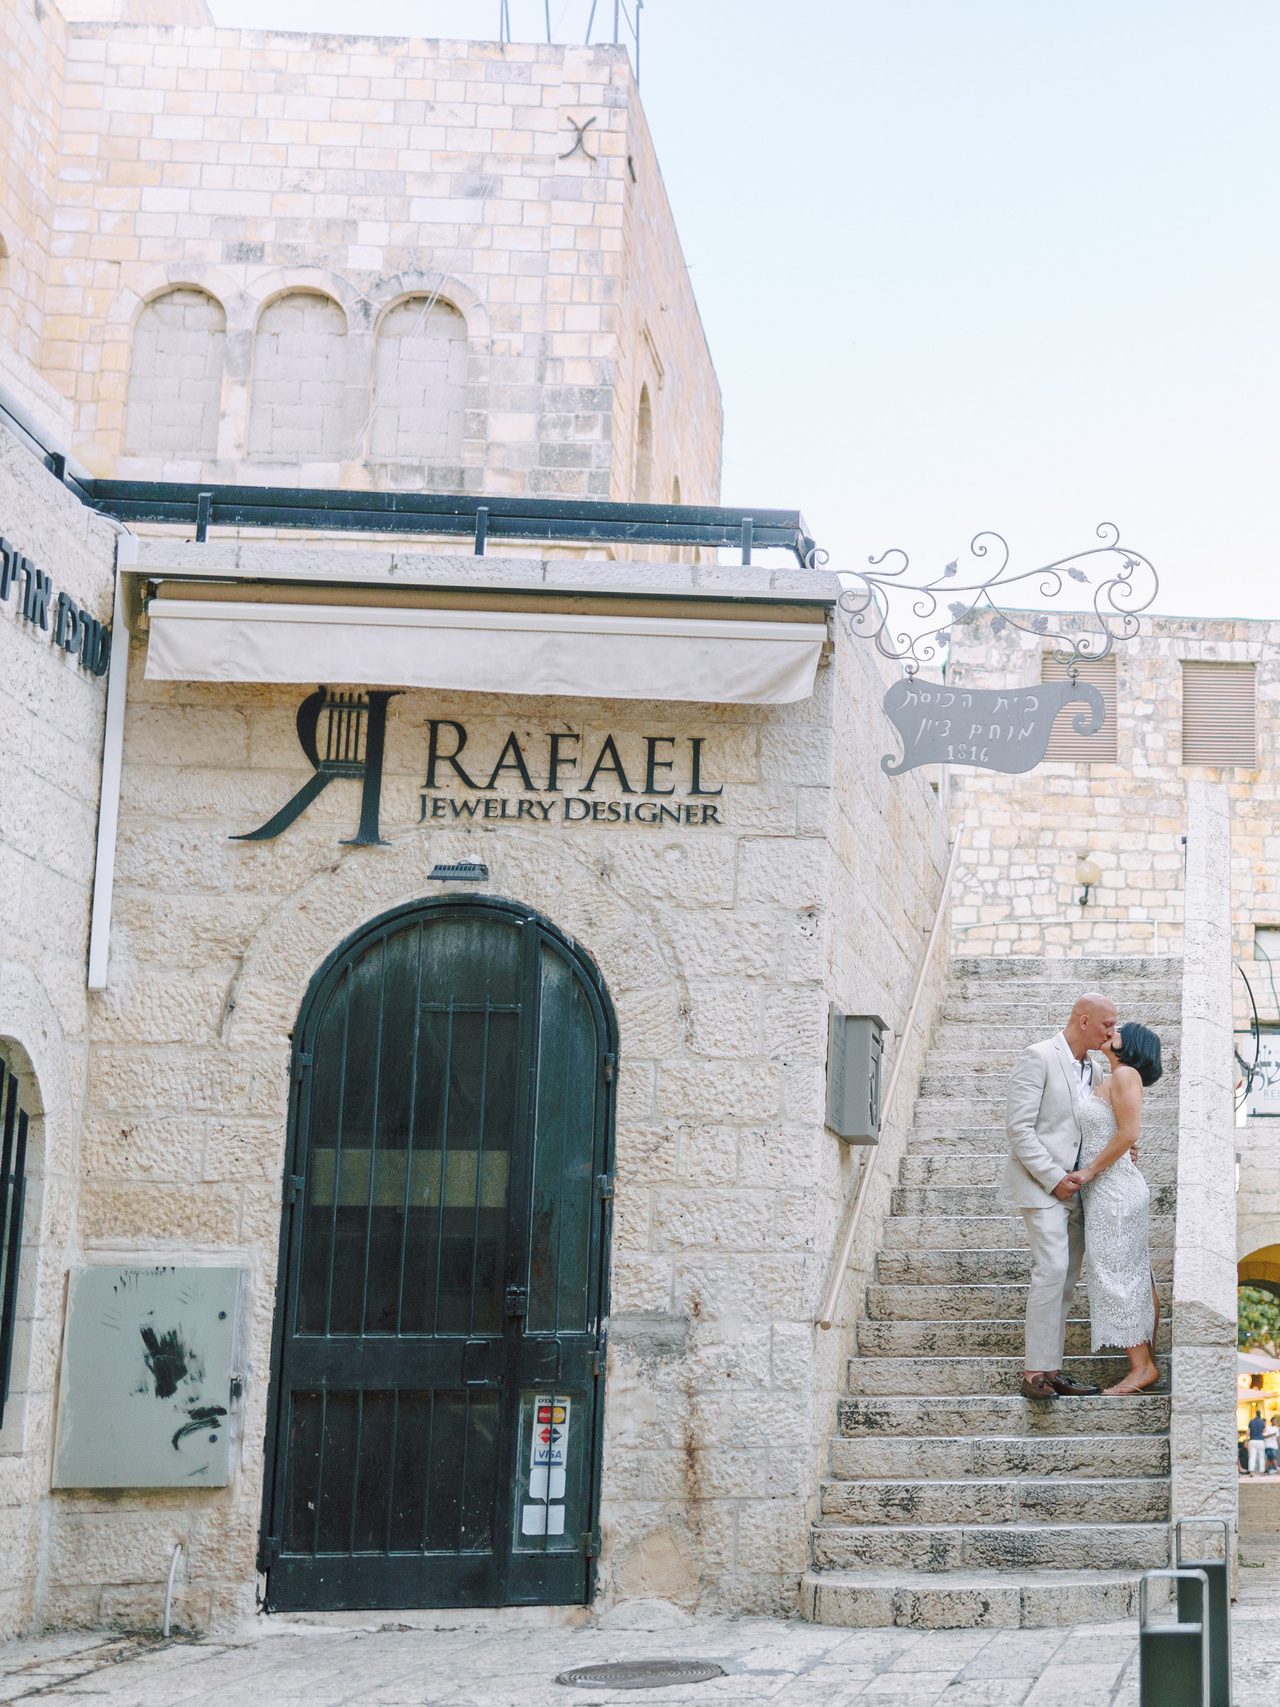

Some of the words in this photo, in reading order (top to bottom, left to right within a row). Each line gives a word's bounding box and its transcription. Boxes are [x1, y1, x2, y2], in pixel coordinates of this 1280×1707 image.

[896, 690, 972, 710] הכנסת
[992, 695, 1038, 714] בית
[914, 718, 951, 746] ציון
[968, 722, 1034, 740] מנחם
[422, 719, 724, 796] RAFAEL
[946, 744, 989, 762] 1816
[418, 794, 555, 824] JEWELRY
[564, 798, 722, 824] DESIGNER
[538, 1450, 562, 1458] VISA
